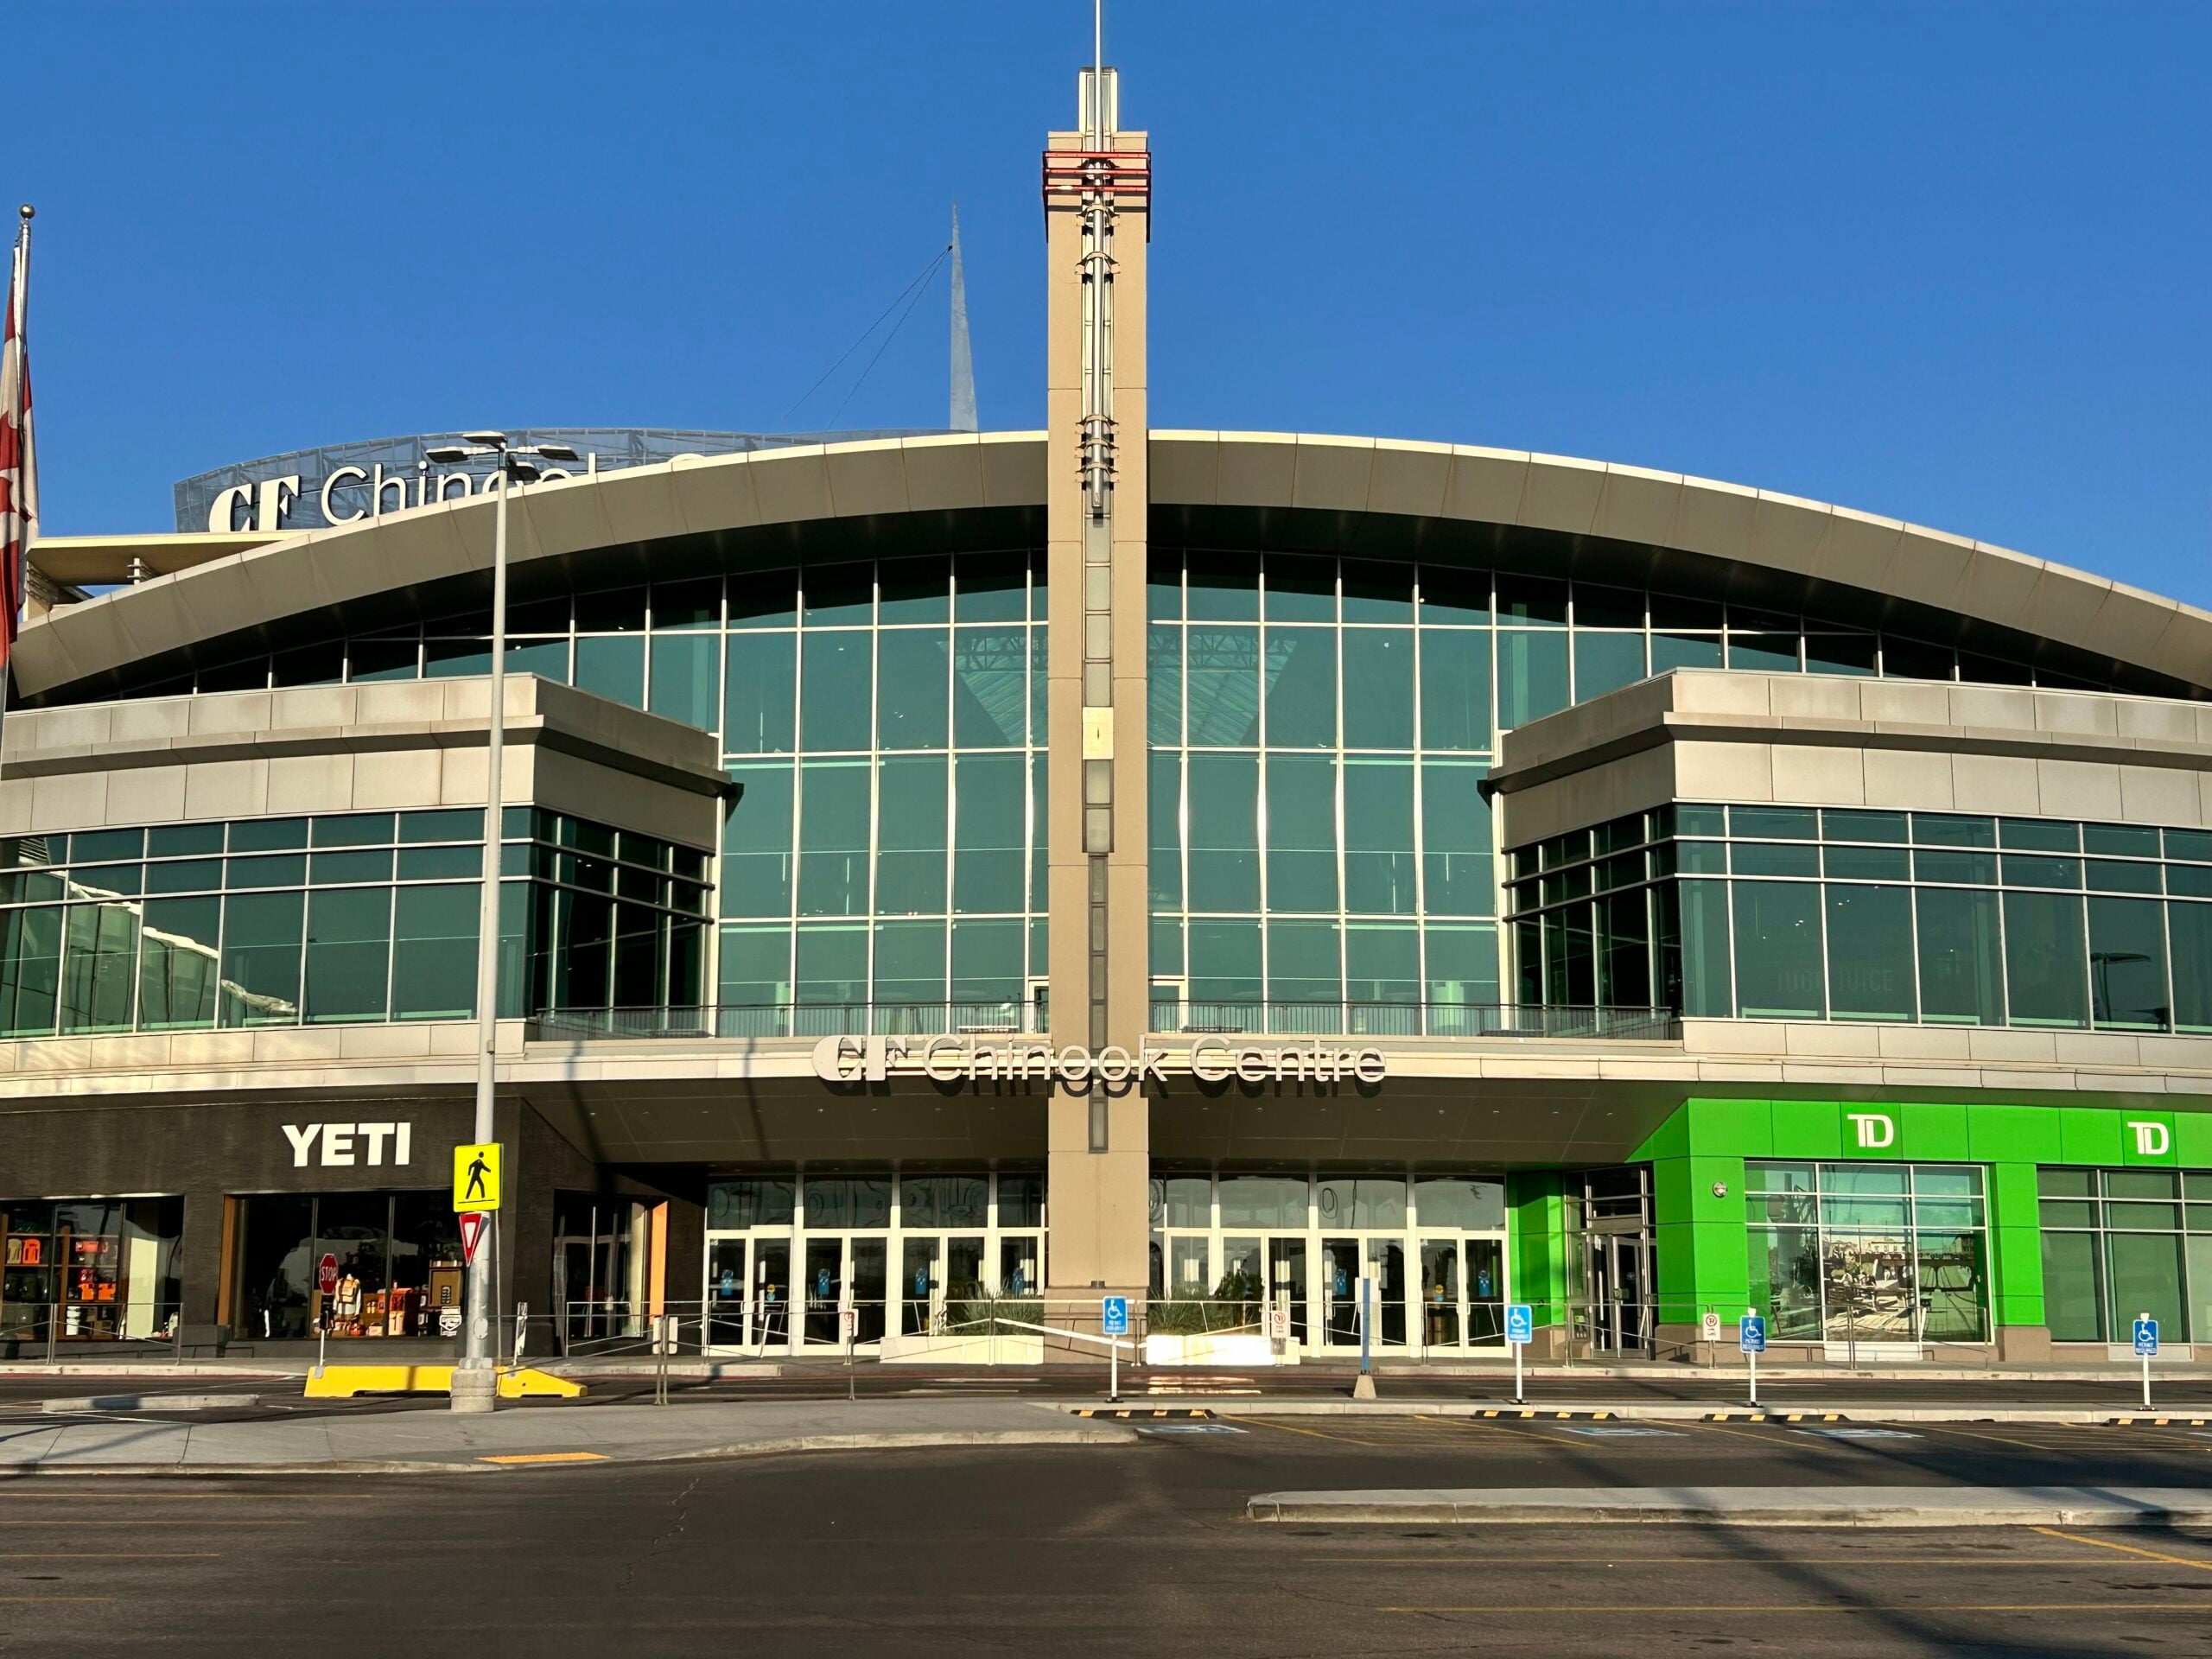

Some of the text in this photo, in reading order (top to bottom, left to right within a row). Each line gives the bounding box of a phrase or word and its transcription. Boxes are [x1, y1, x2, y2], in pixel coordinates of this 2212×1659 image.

[209, 474, 301, 532] CF
[812, 1033, 1386, 1083] CF Chinook Centre
[281, 1122, 410, 1166] YETI
[1847, 1114, 1894, 1147] TD
[2127, 1122, 2169, 1154] TD
[321, 1266, 336, 1281] STOP
